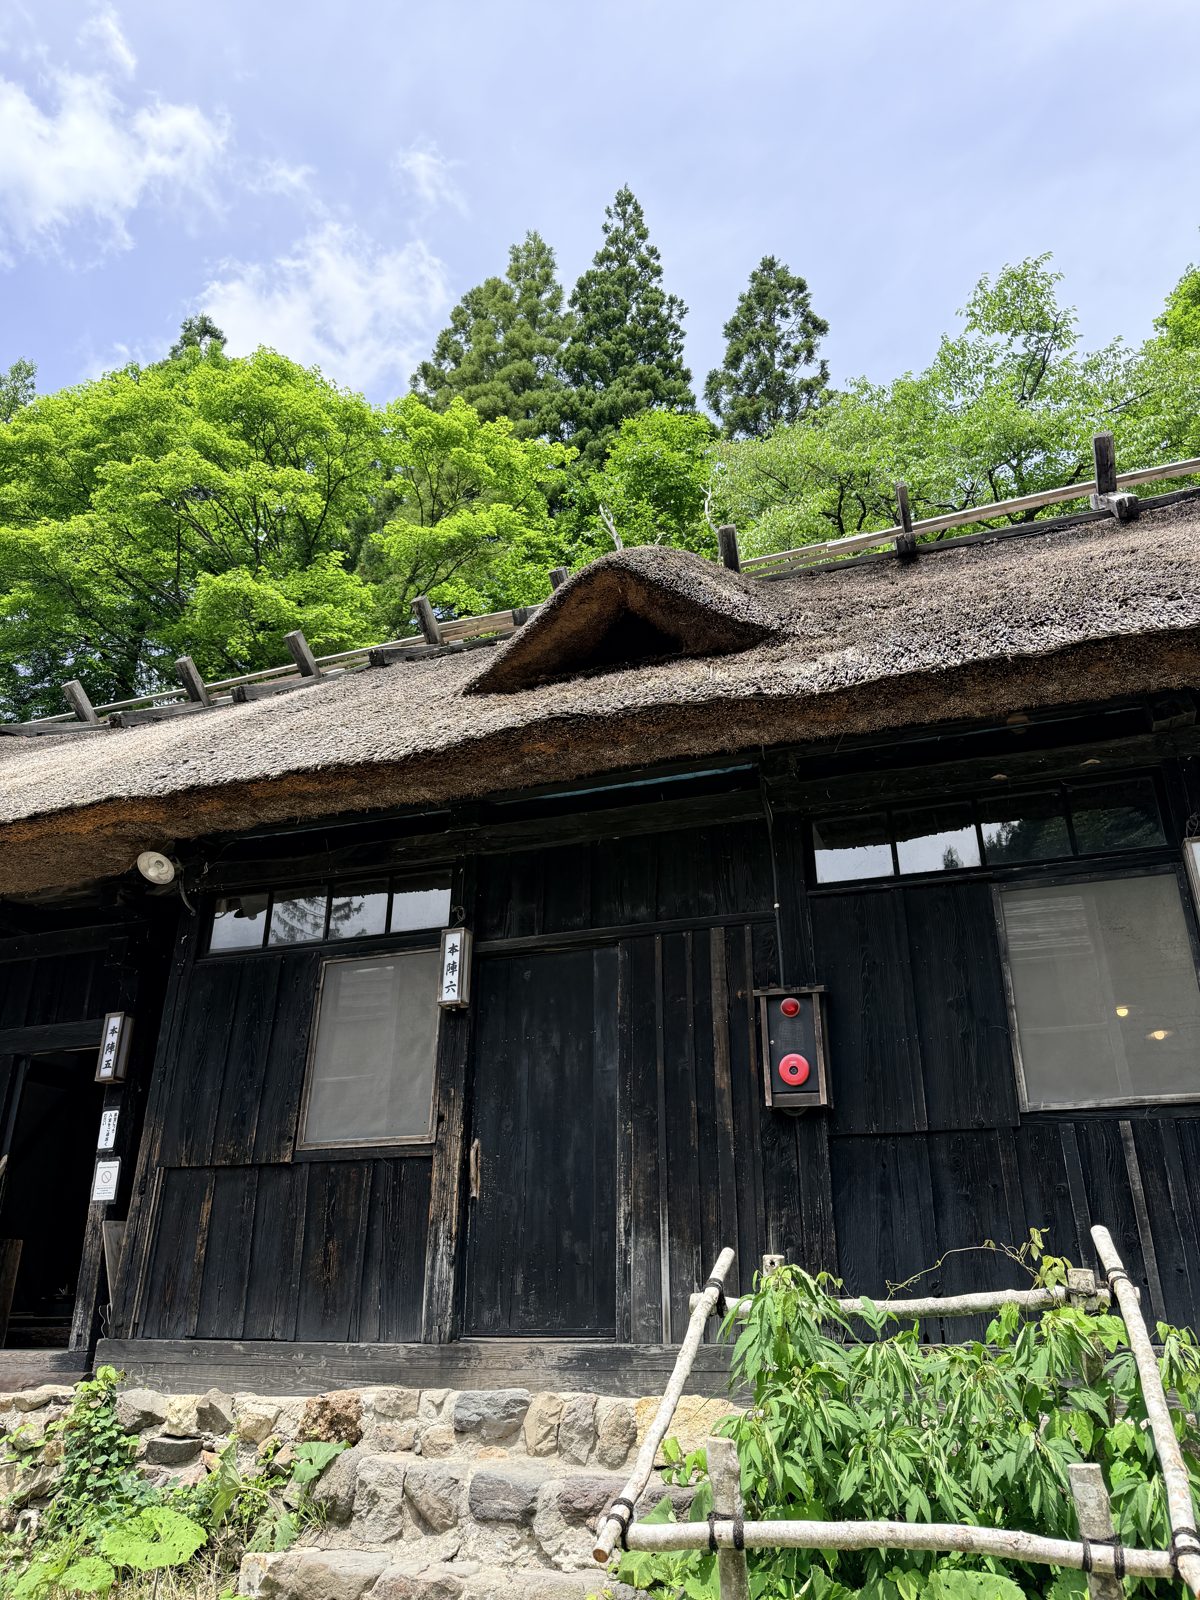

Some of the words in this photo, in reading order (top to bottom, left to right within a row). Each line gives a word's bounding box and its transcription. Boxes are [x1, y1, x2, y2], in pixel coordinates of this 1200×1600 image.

[444, 942, 460, 994] 本陣六
[102, 1025, 119, 1070] 本陣五
